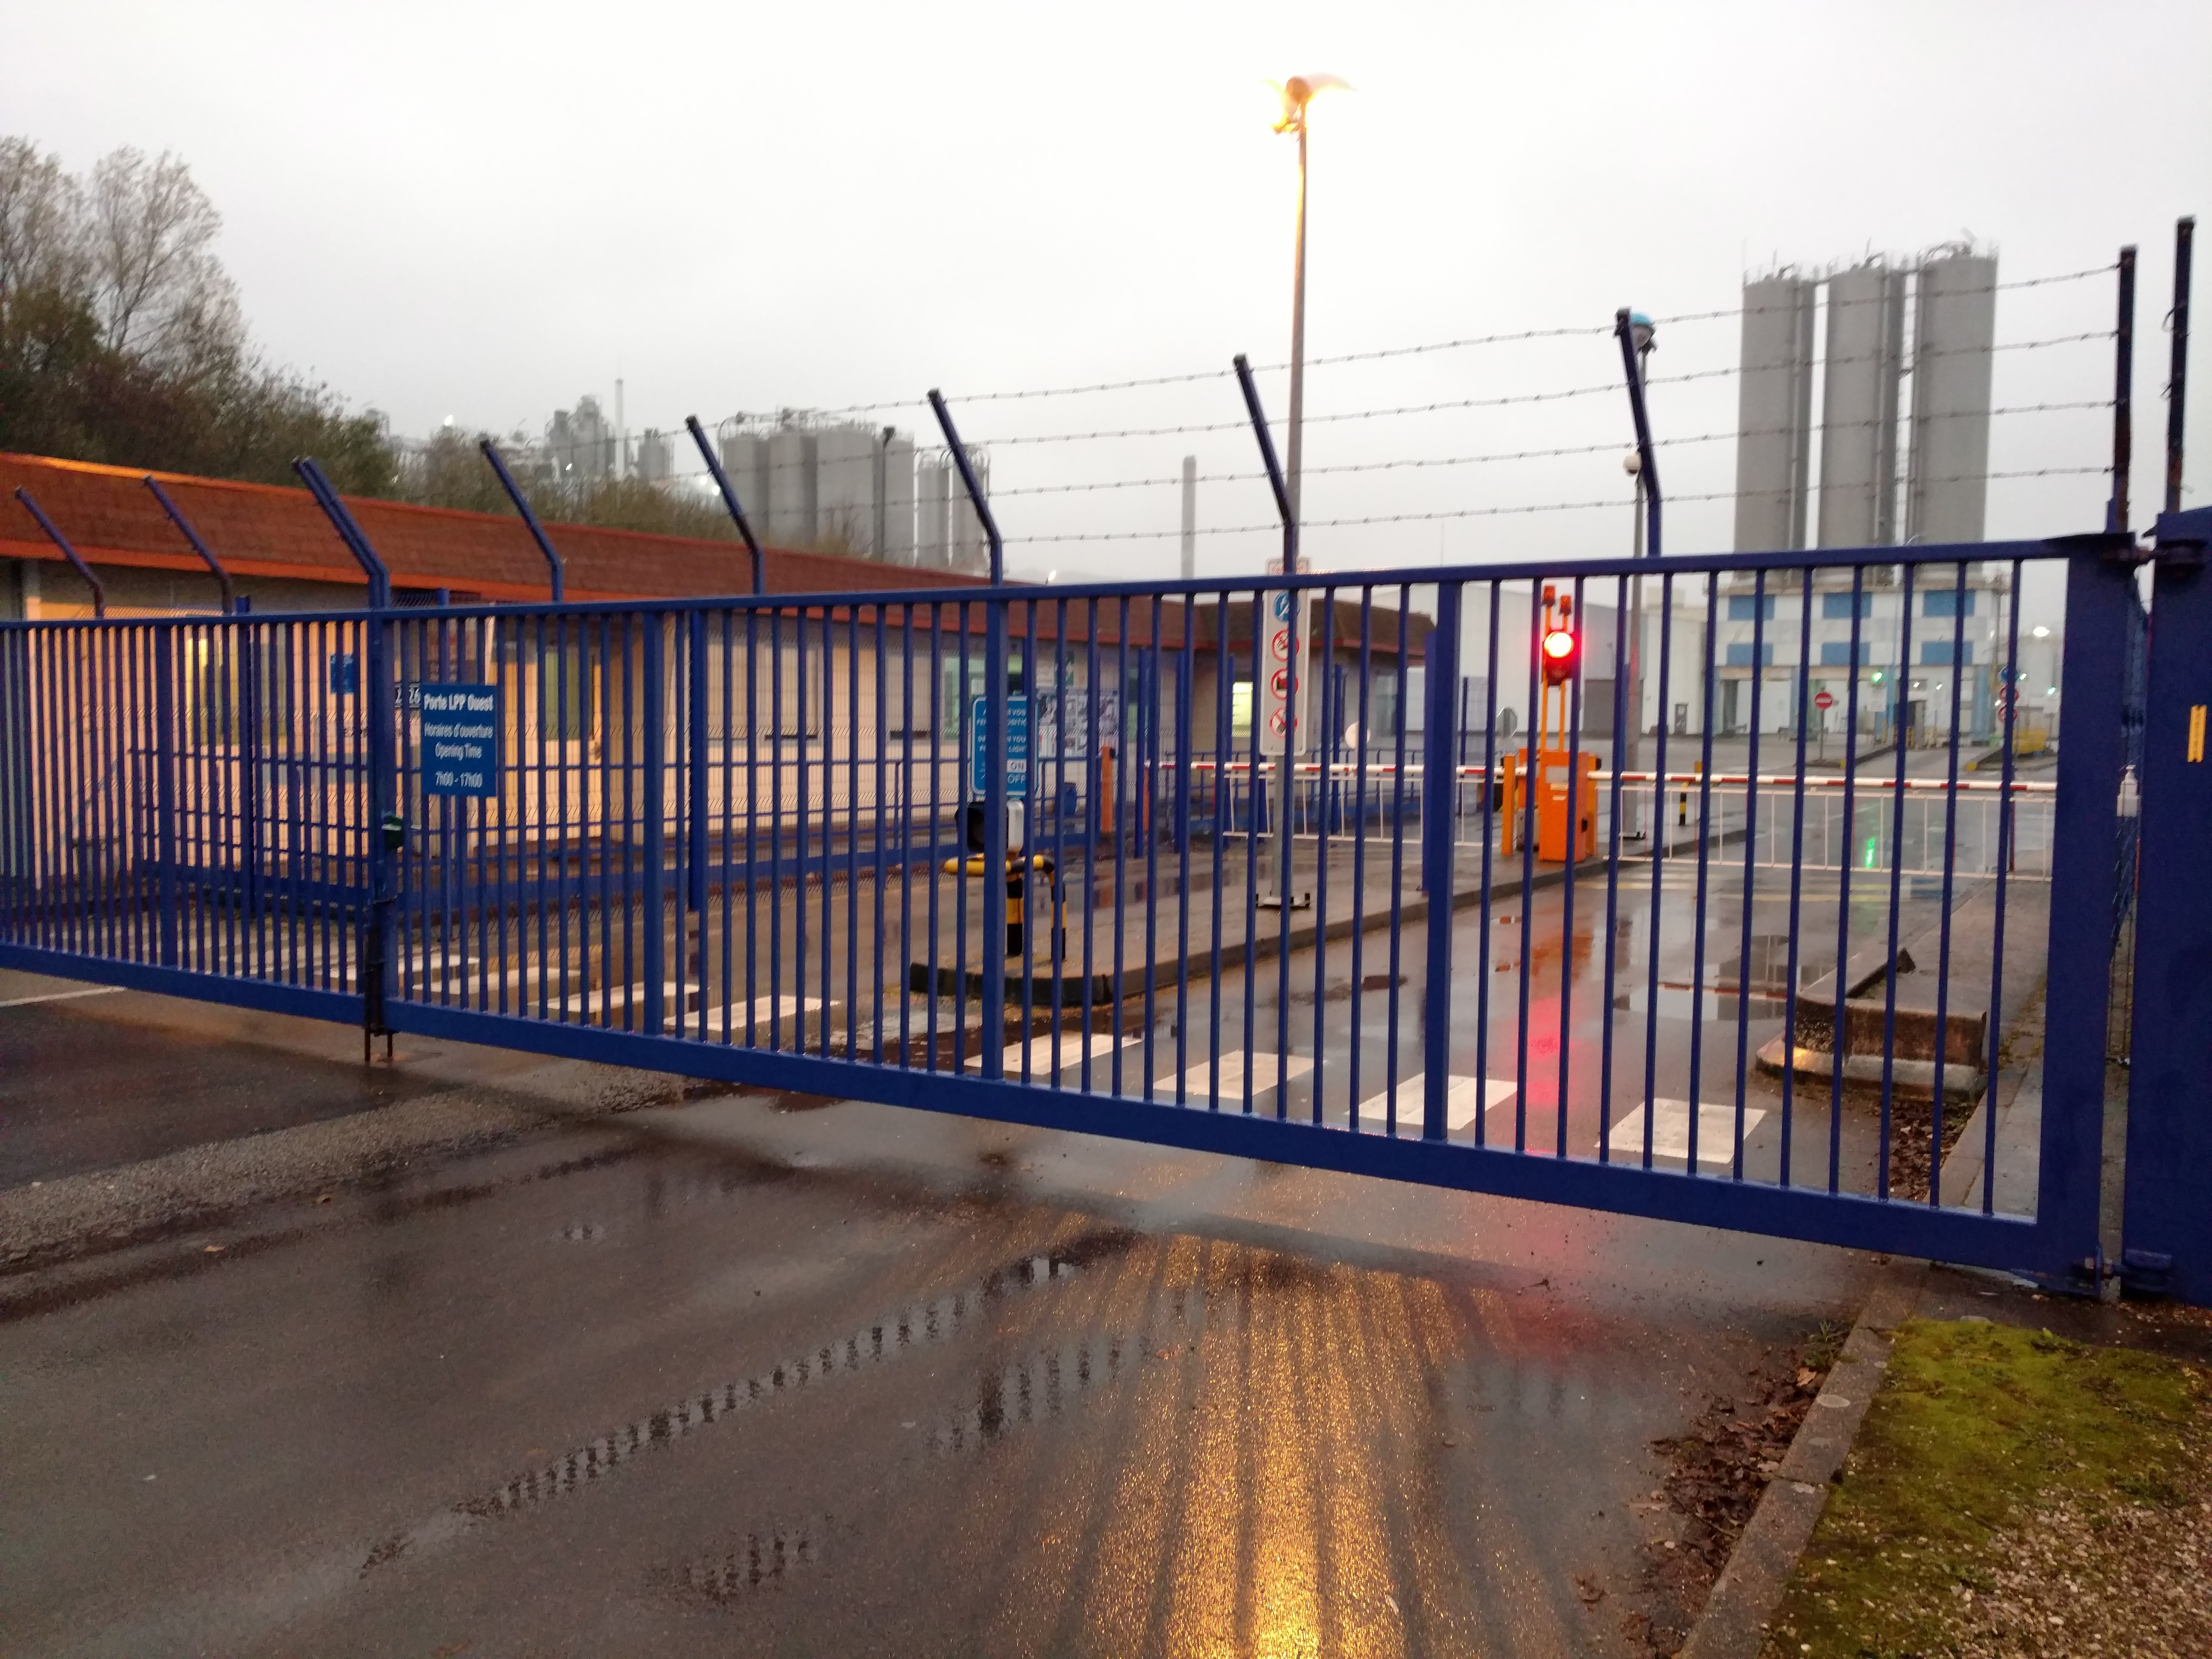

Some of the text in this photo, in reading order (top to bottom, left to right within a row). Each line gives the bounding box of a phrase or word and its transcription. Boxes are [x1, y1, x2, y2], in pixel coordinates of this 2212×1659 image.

[424, 693, 494, 712] Porte LPP Ouest
[424, 721, 453, 737] Horaires
[435, 741, 482, 761] Opening Time
[1010, 762, 1024, 772] ON
[435, 770, 454, 786] 7h00
[459, 772, 483, 788] 17h00
